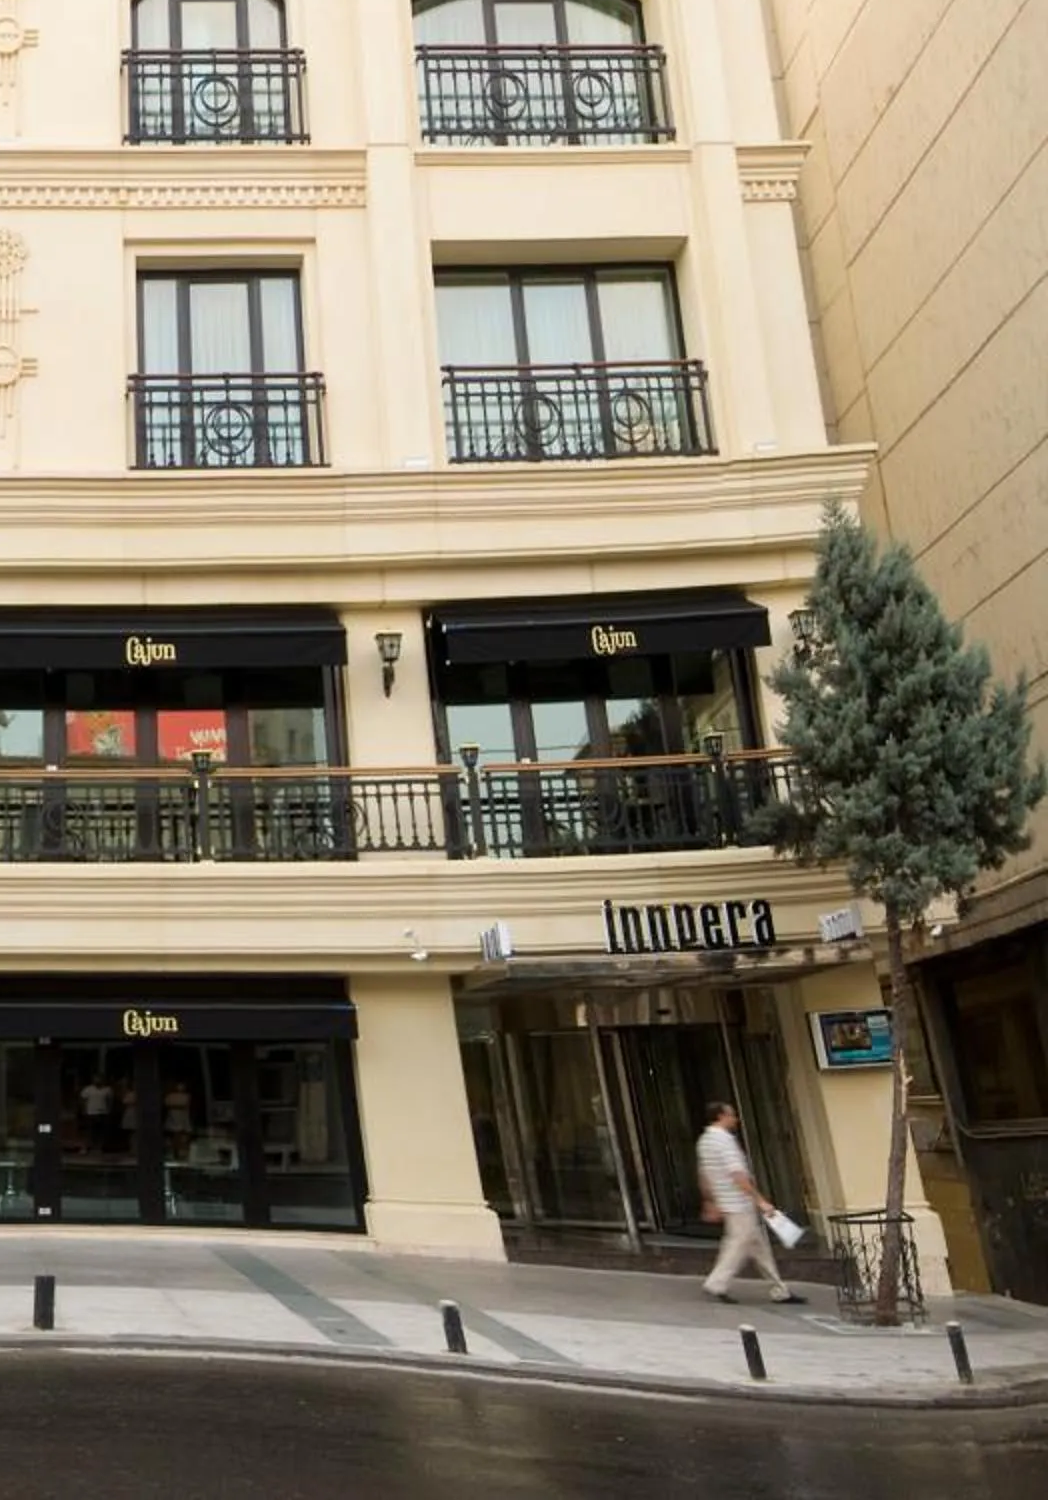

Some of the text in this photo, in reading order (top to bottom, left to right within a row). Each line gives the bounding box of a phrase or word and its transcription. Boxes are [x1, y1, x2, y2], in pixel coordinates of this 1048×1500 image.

[126, 636, 176, 666] Cajun
[592, 625, 637, 654] Cajun
[123, 1010, 178, 1036] Cajun
